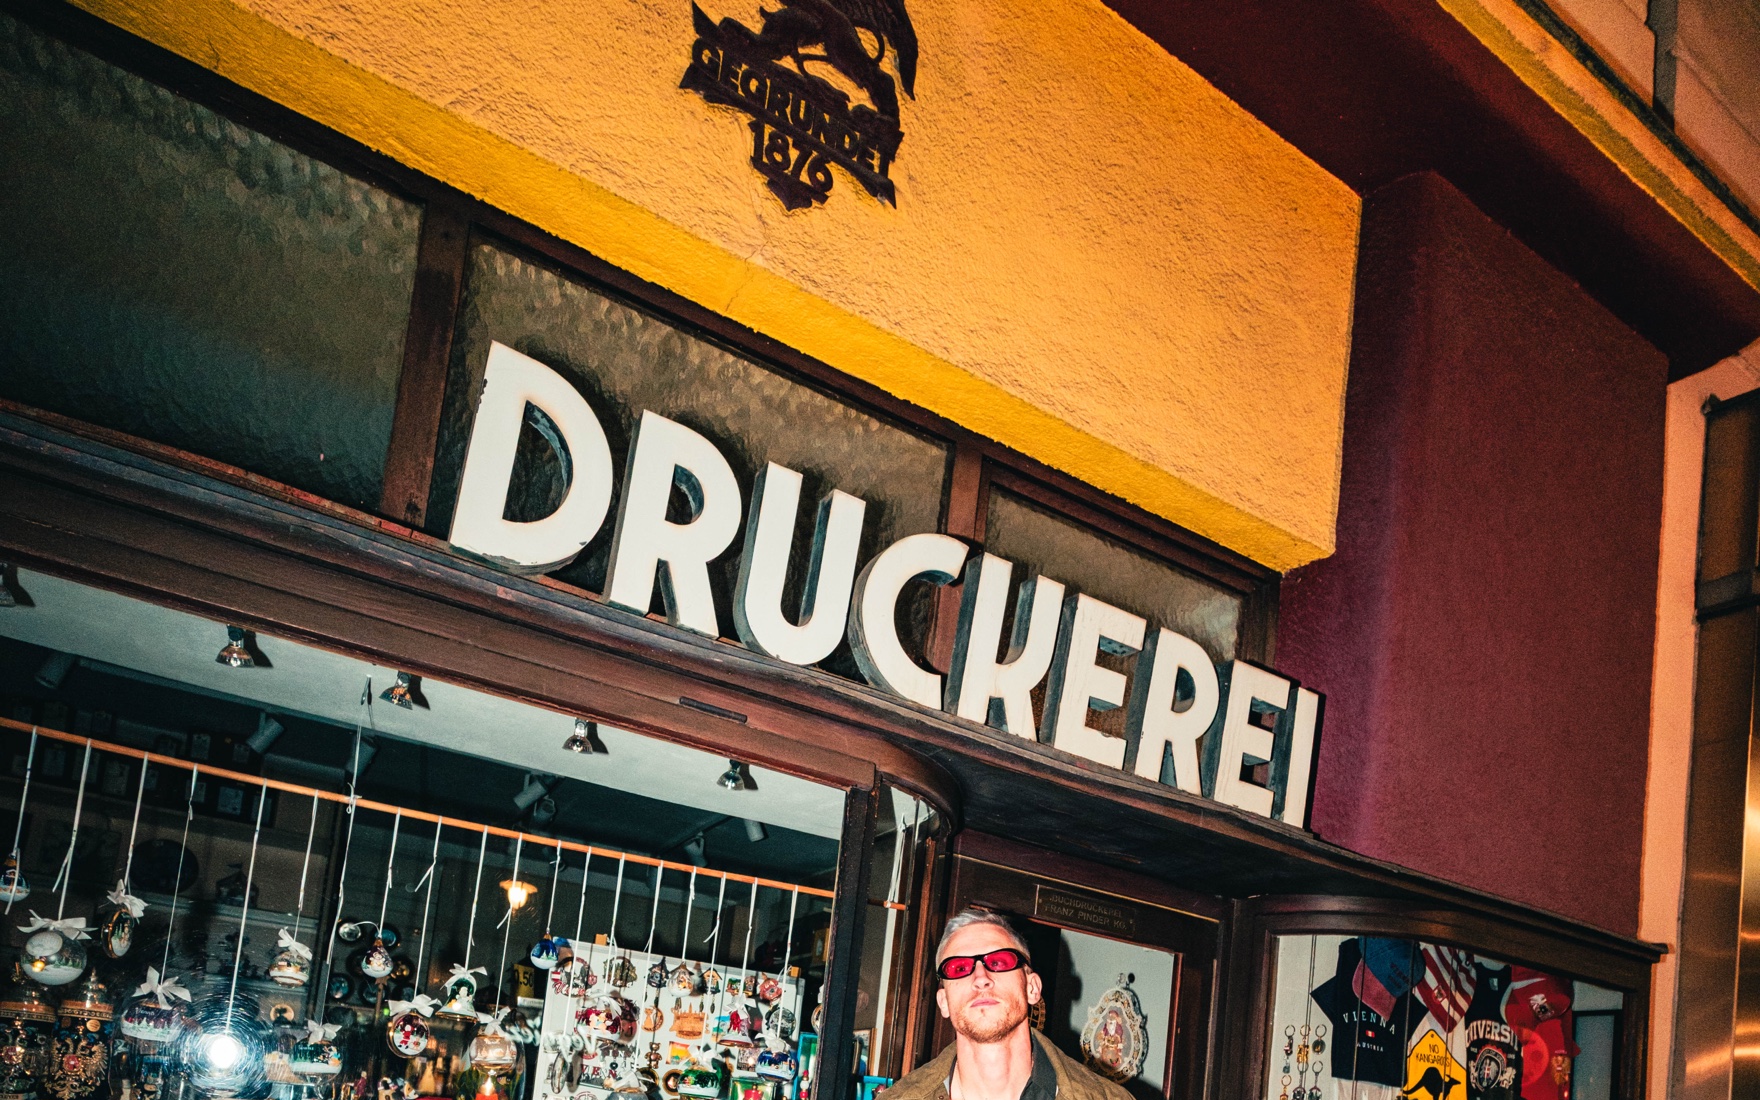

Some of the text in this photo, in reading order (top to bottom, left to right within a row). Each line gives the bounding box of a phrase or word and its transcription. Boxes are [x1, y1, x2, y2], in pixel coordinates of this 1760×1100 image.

[745, 119, 834, 193] 1876
[449, 338, 1323, 832] DRUCKEREI
[1077, 911, 1110, 926] PINDER
[1342, 1010, 1396, 1035] VIENNA
[1428, 1043, 1440, 1054] NO
